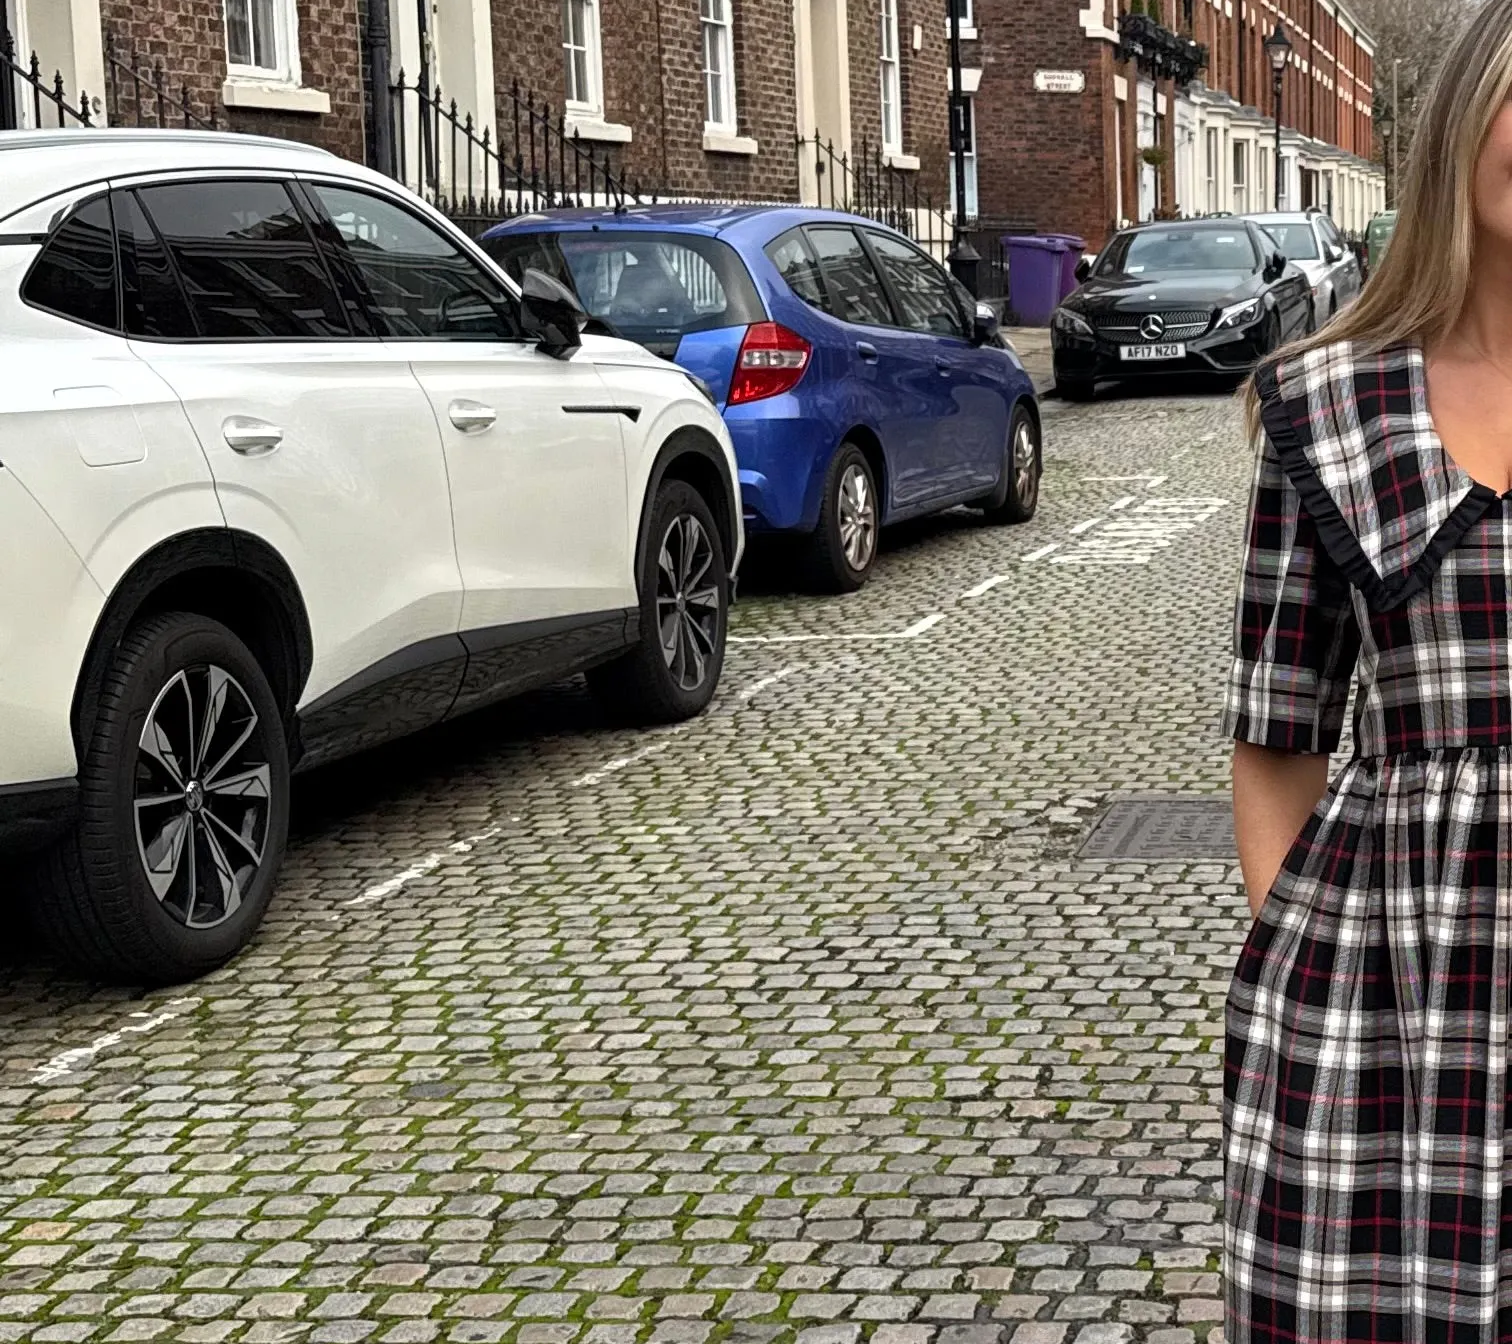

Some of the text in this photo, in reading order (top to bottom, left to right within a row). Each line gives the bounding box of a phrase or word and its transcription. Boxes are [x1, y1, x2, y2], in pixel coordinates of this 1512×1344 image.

[1046, 82, 1071, 90] STREET
[1127, 344, 1179, 358] AF17 NZO
[1050, 497, 1230, 564] DISABLED
